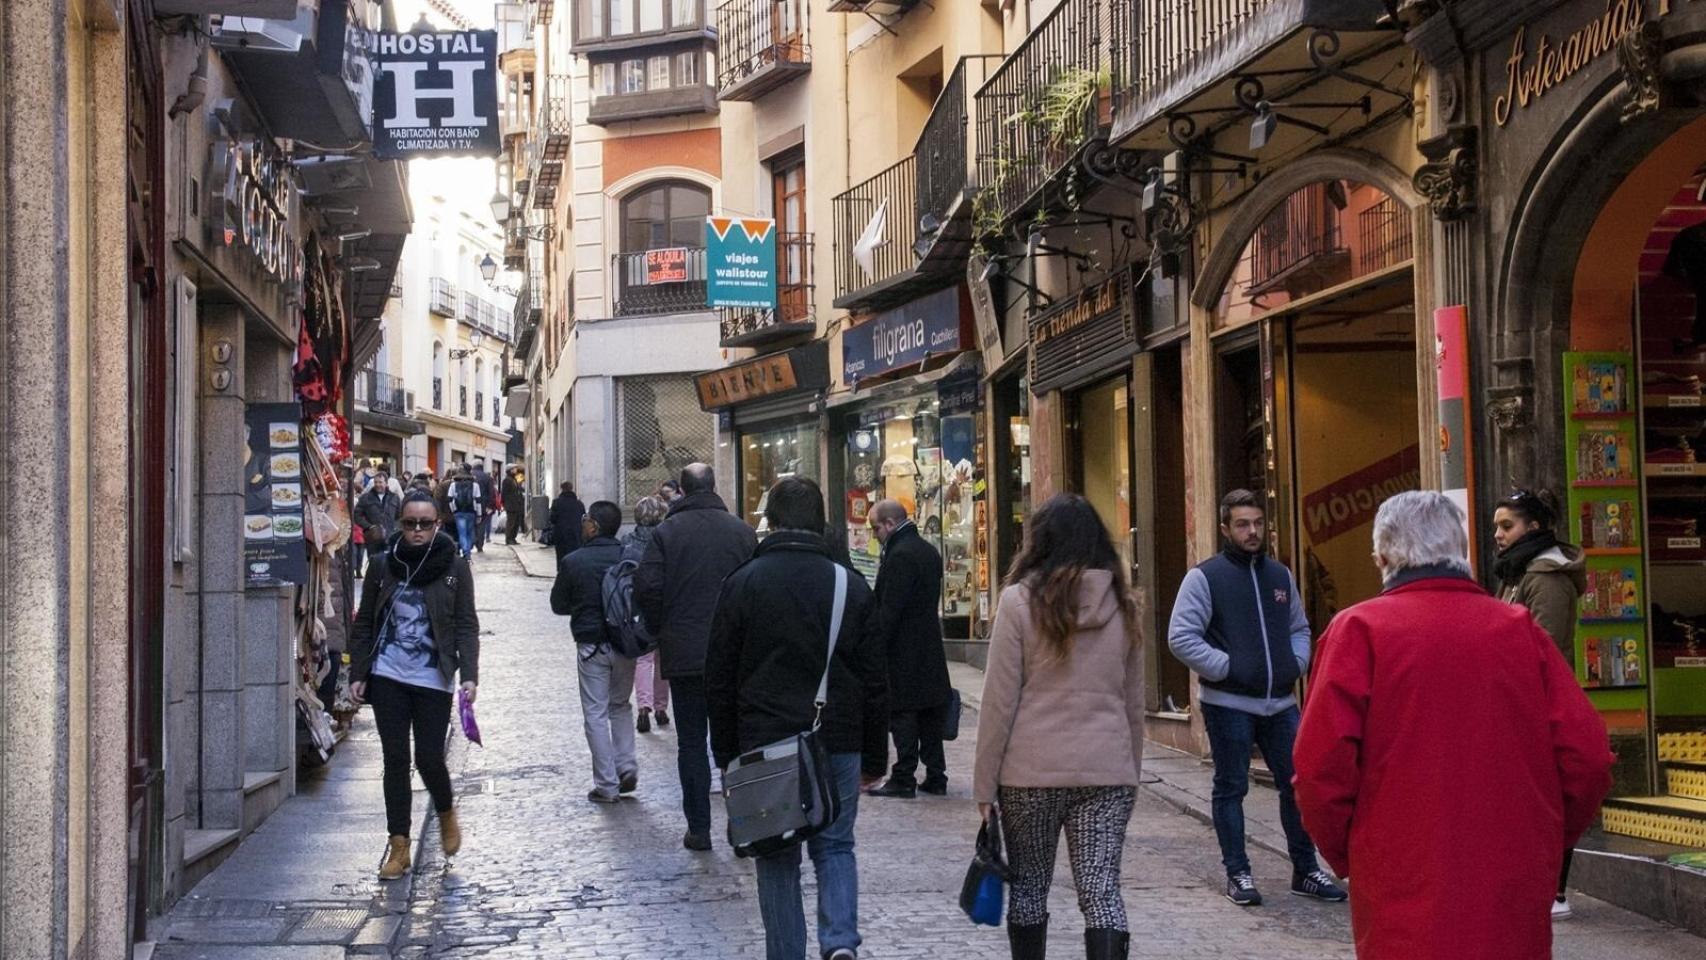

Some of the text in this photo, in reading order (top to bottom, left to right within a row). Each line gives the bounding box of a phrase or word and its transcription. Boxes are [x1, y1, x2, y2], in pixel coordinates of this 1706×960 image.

[380, 33, 484, 54] HOSTAL
[381, 61, 488, 128] H
[389, 126, 480, 139] HABITACION CON BAÑO
[396, 139, 473, 150] CLIMATIZADA Y T.V.
[725, 252, 759, 265] viajes
[715, 267, 769, 279] walistour
[872, 318, 925, 366] filigrana
